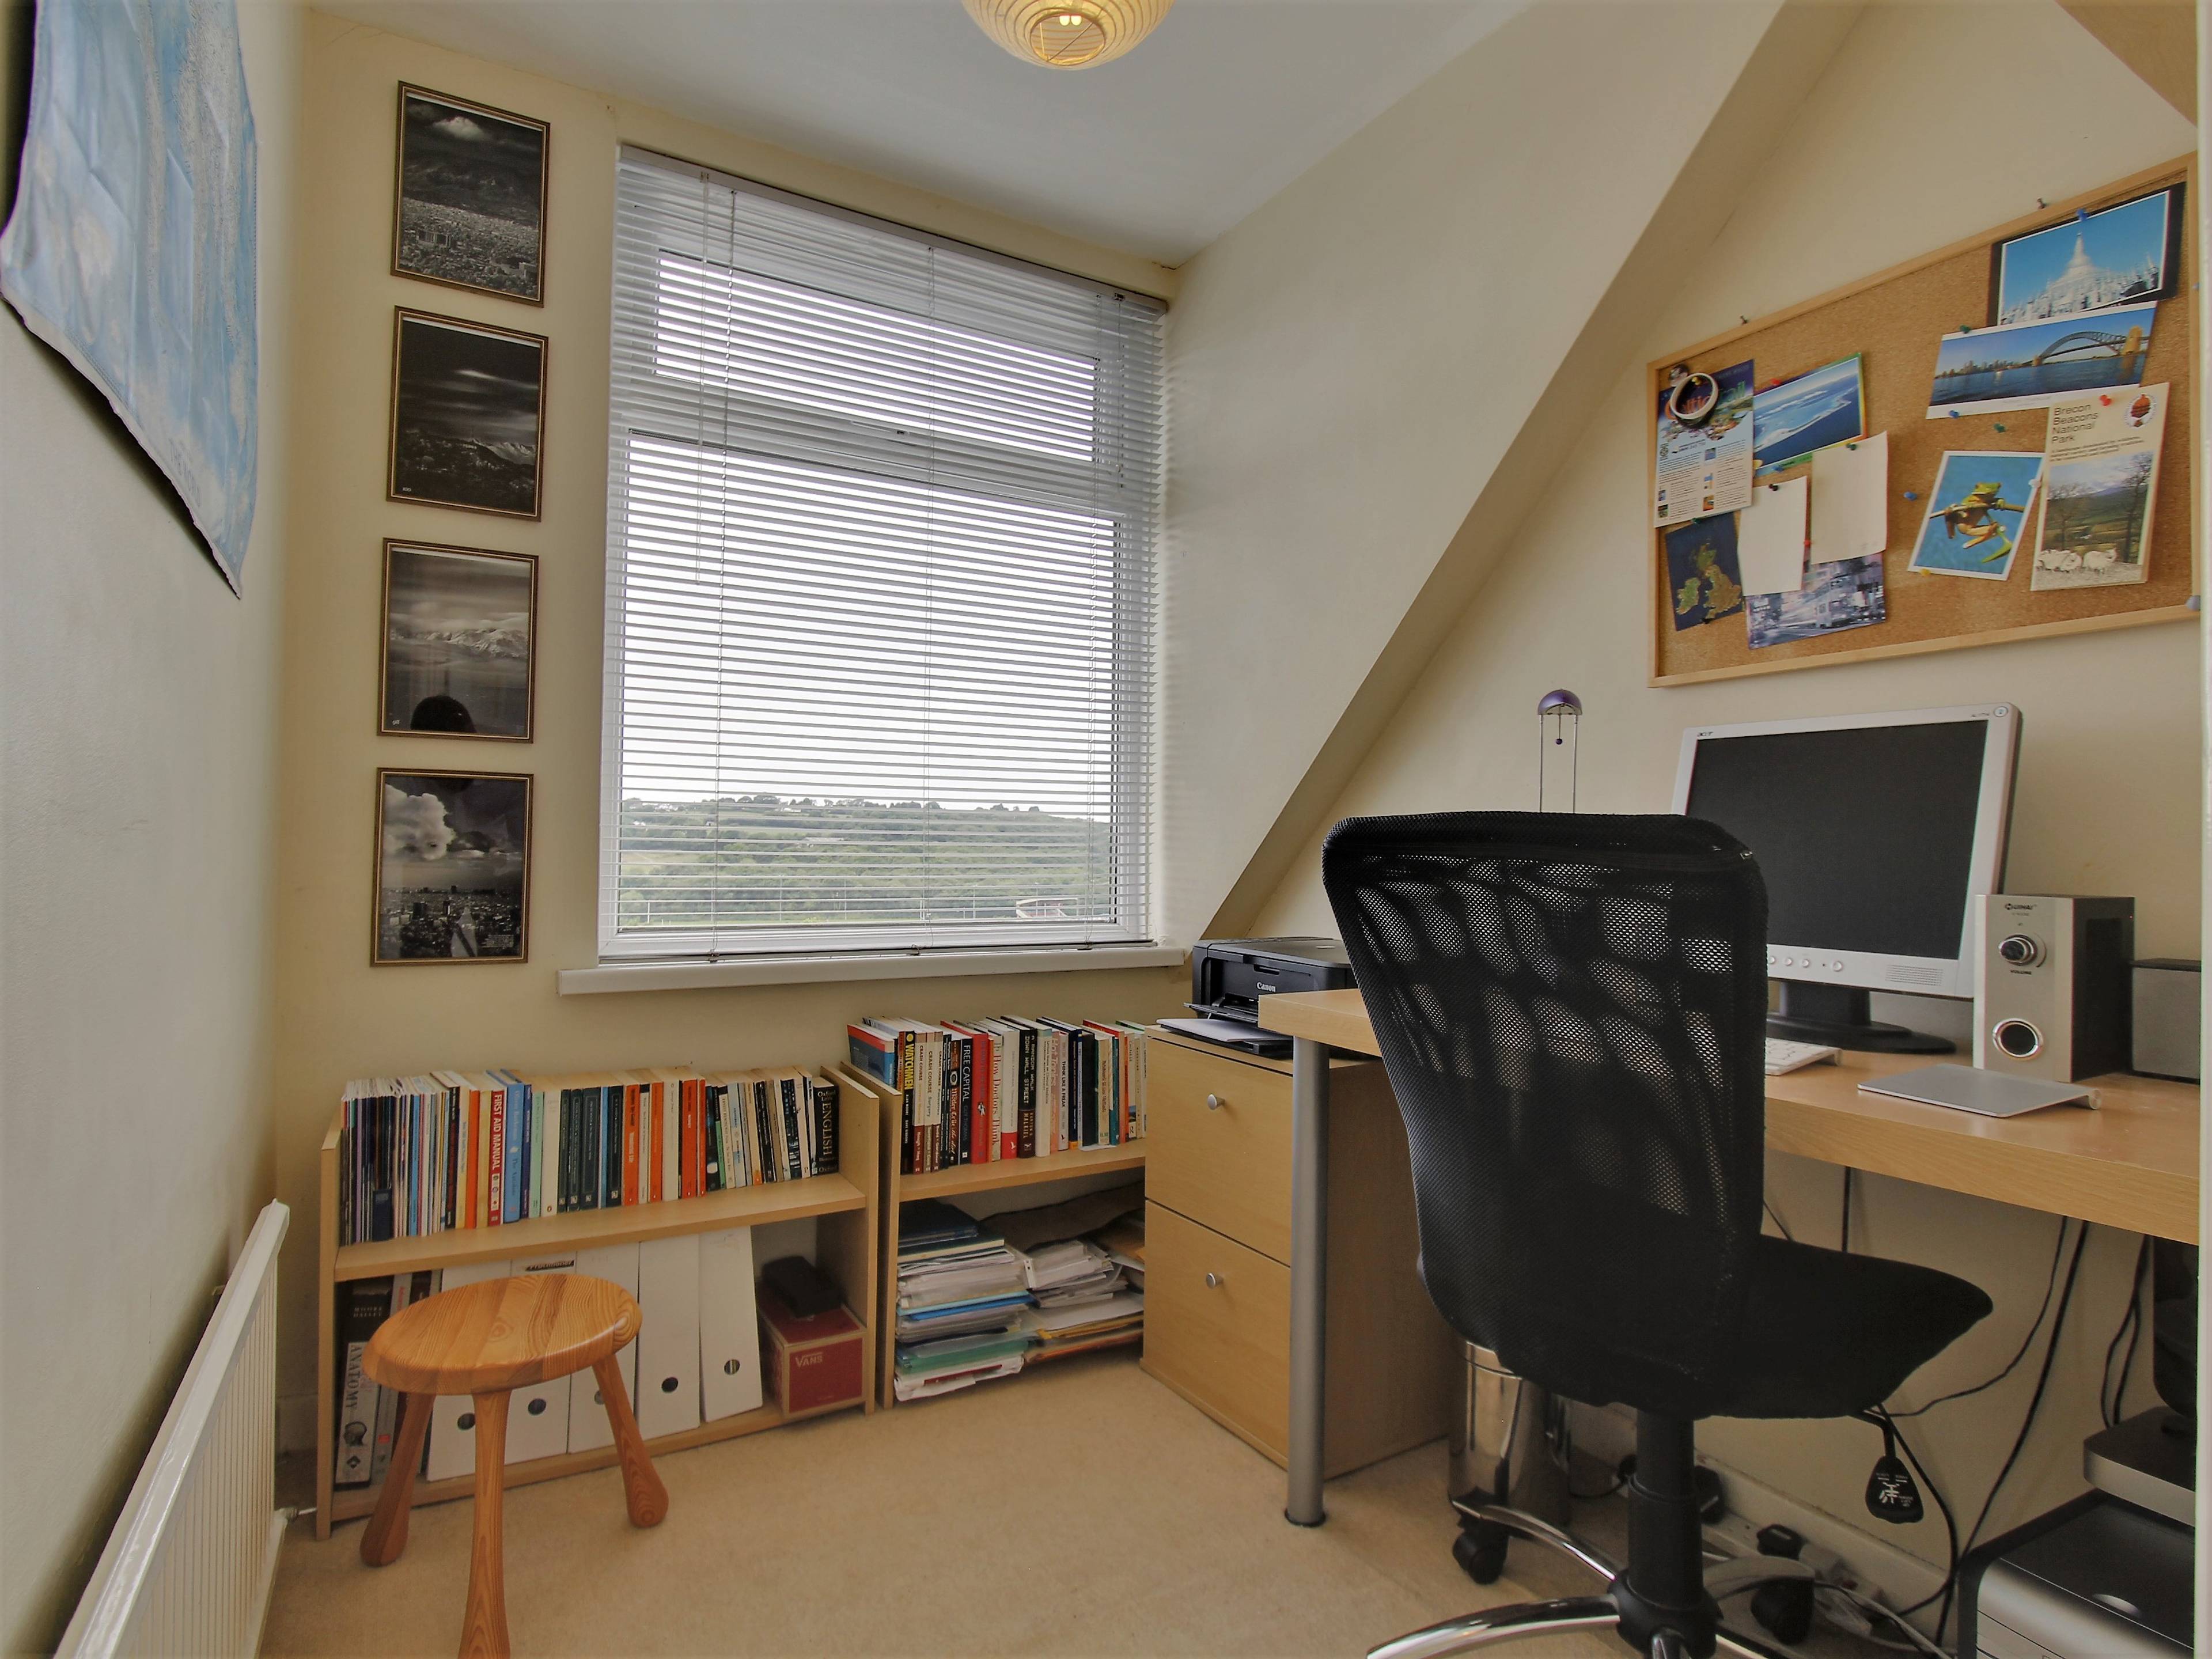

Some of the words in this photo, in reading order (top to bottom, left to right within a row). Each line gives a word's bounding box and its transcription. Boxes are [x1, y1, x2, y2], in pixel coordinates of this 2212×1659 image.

[2054, 404, 2091, 415] Brecon
[2054, 412, 2098, 425] Beacons
[2052, 421, 2095, 434] National
[2052, 434, 2075, 444] Park
[1256, 982, 1276, 993] Canon
[904, 1044, 914, 1090] WATCHMEN
[993, 1055, 1001, 1074] How
[963, 1067, 971, 1101] CAPITAL
[494, 1094, 502, 1116] FIRST
[993, 1078, 1001, 1115] Doctors
[493, 1118, 501, 1132] AID
[822, 1103, 832, 1156] ENGLISH
[992, 1119, 1000, 1146] Think
[492, 1134, 501, 1170] MANUAL
[795, 1352, 823, 1368] VANS
[345, 1344, 362, 1410] ANATOMY
